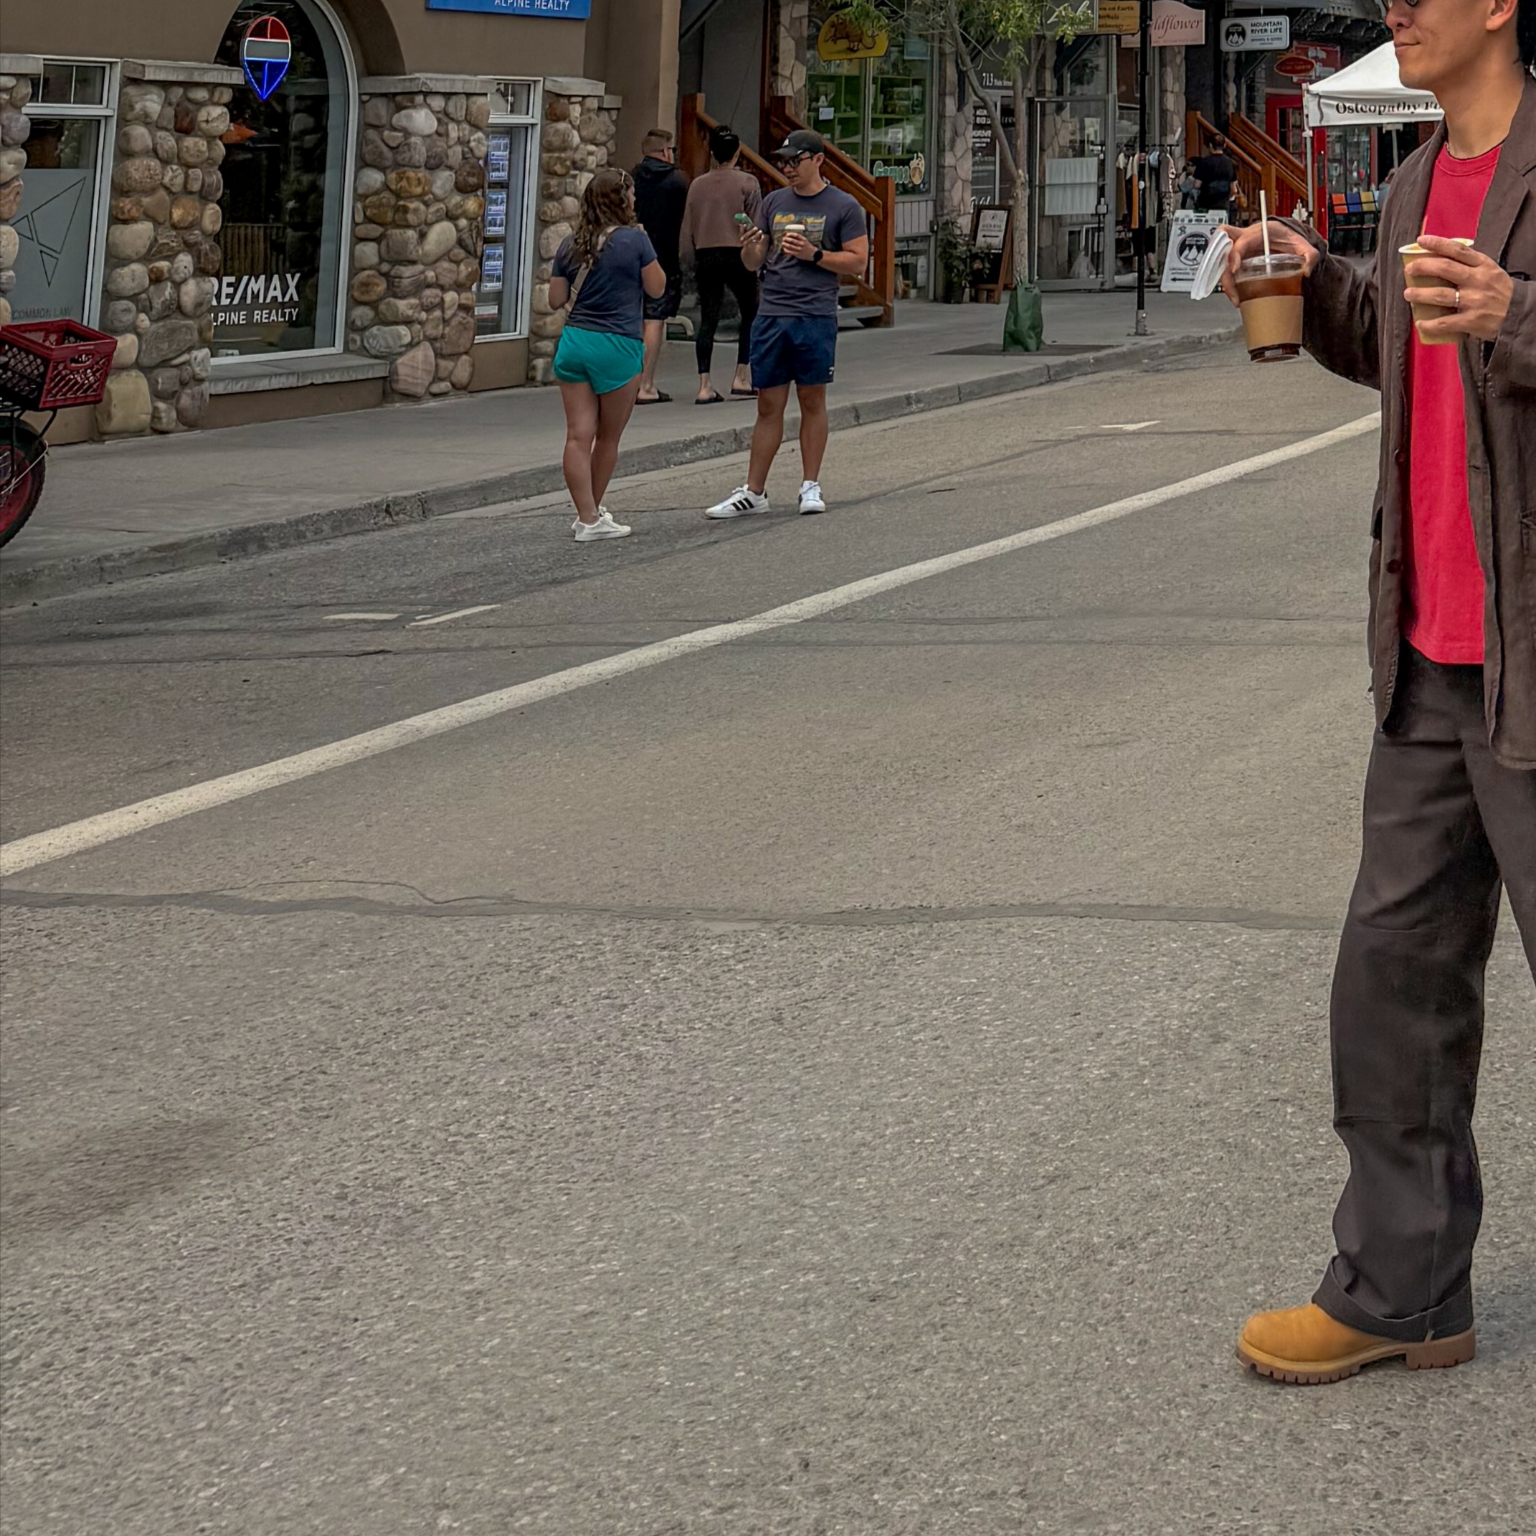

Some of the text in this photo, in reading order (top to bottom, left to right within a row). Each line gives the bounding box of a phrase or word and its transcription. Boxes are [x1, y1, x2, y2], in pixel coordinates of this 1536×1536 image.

[1151, 14, 1203, 40] ldflower
[1335, 101, 1421, 115] Osteopathy
[211, 308, 299, 326] LPINE REALTY
